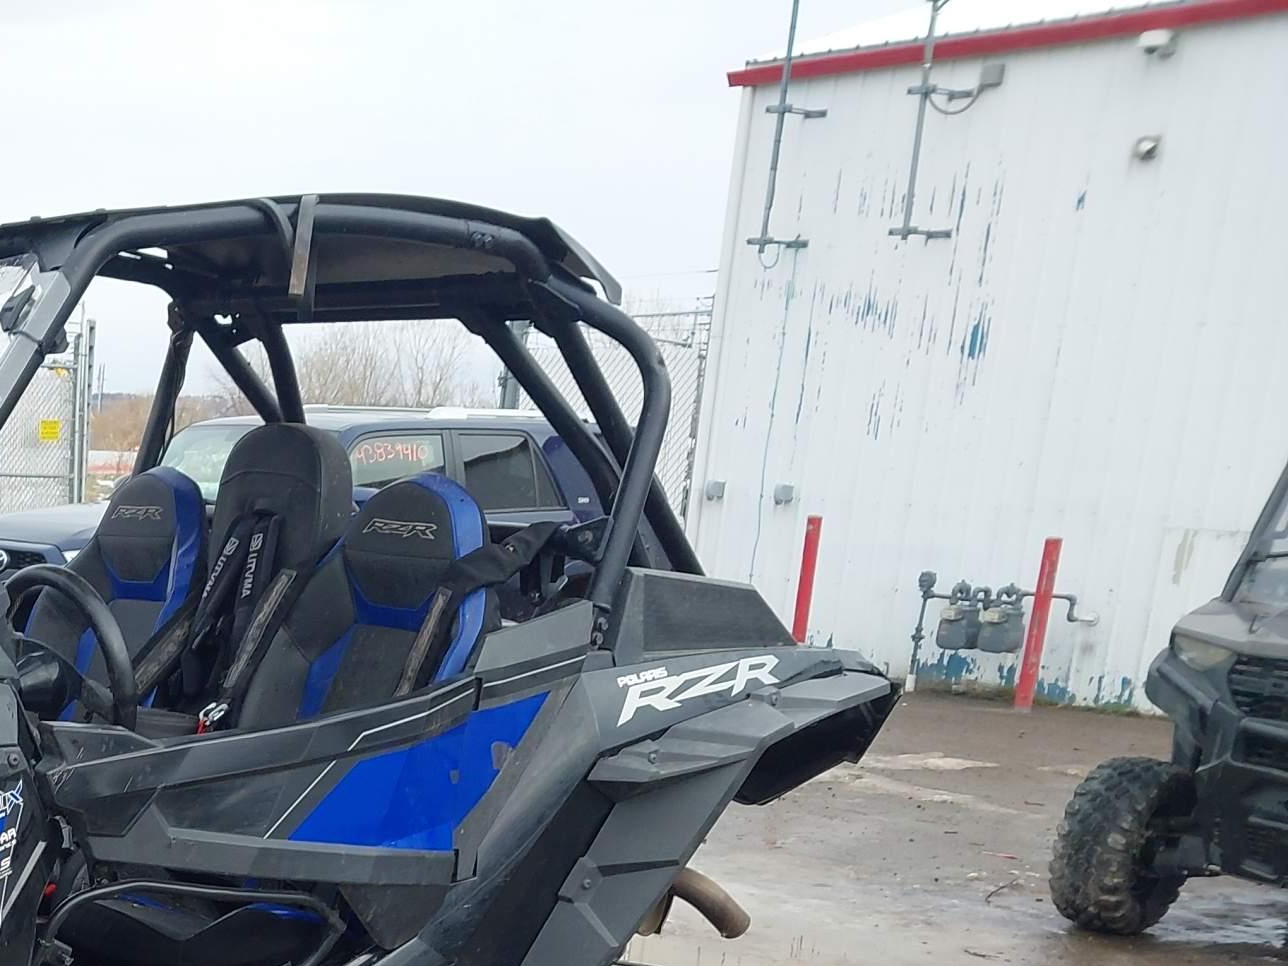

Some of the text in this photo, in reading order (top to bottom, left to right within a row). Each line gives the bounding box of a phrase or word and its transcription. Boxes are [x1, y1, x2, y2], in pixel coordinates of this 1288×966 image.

[111, 505, 164, 521] RZR
[362, 518, 438, 540] RZR
[616, 665, 668, 688] POLARIS
[616, 654, 781, 727] RZR
